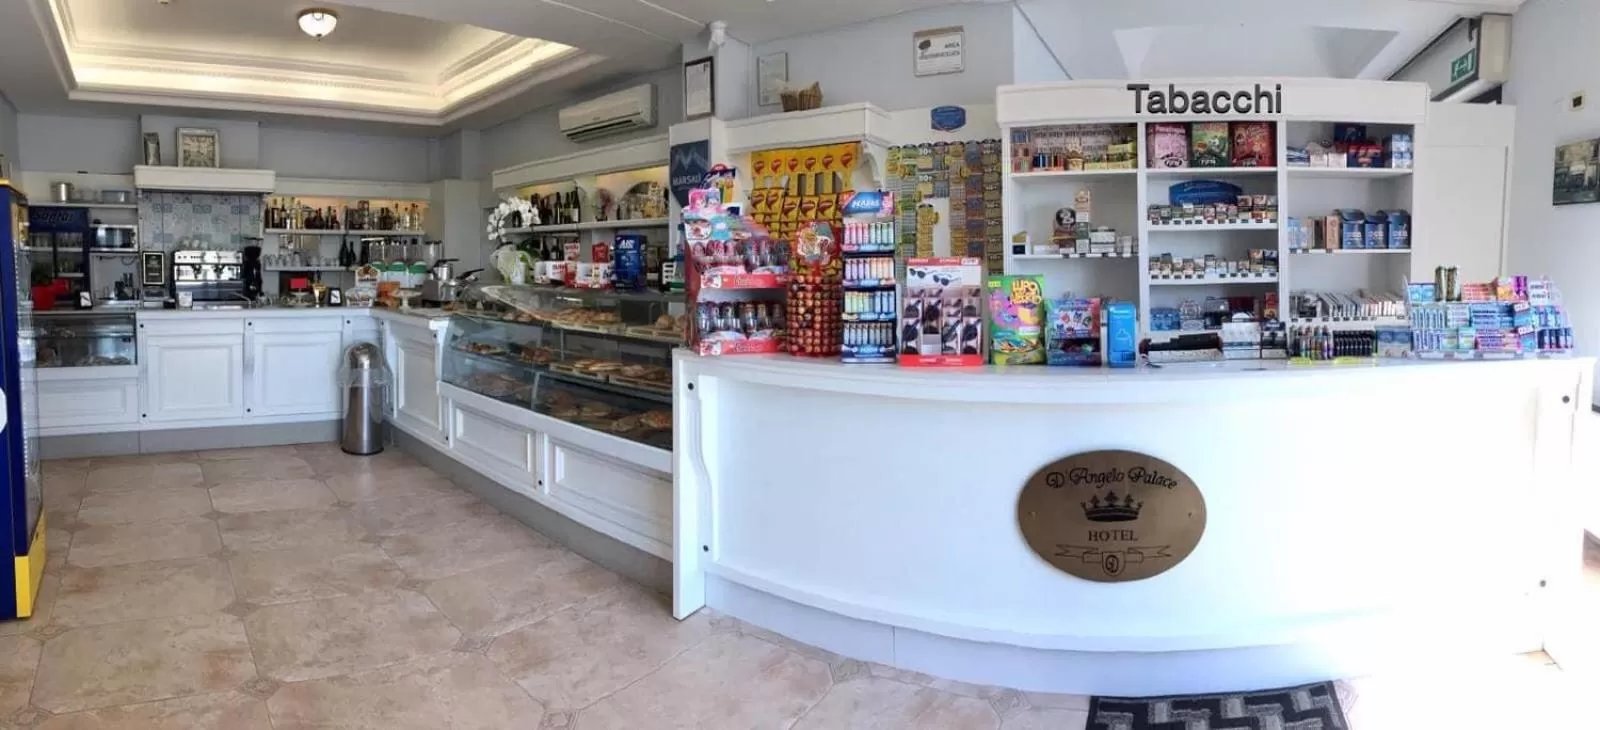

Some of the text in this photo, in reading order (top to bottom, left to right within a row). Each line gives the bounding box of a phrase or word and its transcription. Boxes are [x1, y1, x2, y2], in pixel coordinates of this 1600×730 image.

[1127, 83, 1281, 114] Tabacchi
[1128, 466, 1178, 490] Palace
[1088, 530, 1138, 541] HOTEL
